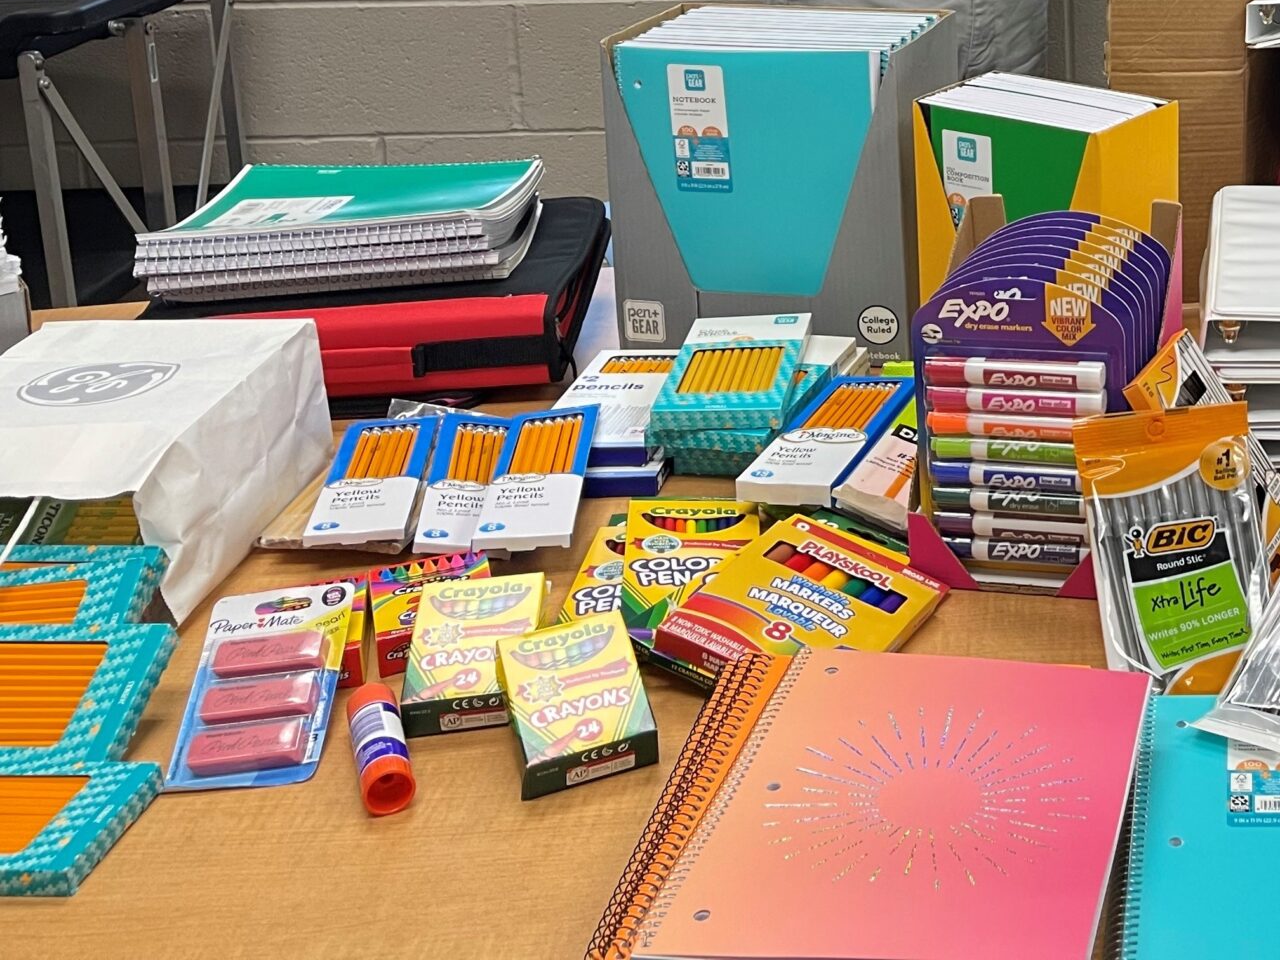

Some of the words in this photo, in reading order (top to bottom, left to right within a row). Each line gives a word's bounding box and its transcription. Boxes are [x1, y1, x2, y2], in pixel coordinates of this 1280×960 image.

[672, 95, 717, 104] NOTEBOOK
[946, 169, 990, 183] COMPOSITION
[946, 175, 964, 184] BOOK
[938, 298, 1010, 328] EXPO
[1049, 297, 1088, 318] NEW
[631, 319, 660, 336] GEAR
[862, 316, 896, 327] College
[964, 322, 978, 332] dry
[1000, 322, 1033, 333] markers
[1051, 316, 1086, 326] VIBRANT
[866, 326, 892, 335] Ruled
[1055, 324, 1082, 334] COLOR
[1061, 332, 1077, 341] MIX
[868, 351, 901, 361] tebook
[571, 383, 645, 392] pencils
[988, 373, 1038, 387] EXPO
[987, 396, 1036, 412] EXPO
[771, 451, 814, 459] Pencils
[1216, 448, 1231, 468] #1
[988, 473, 1037, 489] EXPO
[1214, 473, 1226, 482] Ball
[335, 488, 381, 498] Yellow
[440, 493, 485, 502] Yellow
[497, 492, 544, 502] Pencils
[500, 486, 544, 495] Yellow
[332, 494, 380, 504] Pencils
[437, 500, 484, 509] Pencils
[650, 506, 738, 517] Crayola
[31, 503, 61, 545] TICON
[321, 521, 331, 530] 8
[487, 522, 497, 531] 8
[431, 528, 441, 538] 8
[992, 541, 1041, 562] EXPO
[798, 540, 892, 590] PLAYSKOOL
[1156, 558, 1185, 571] Round
[901, 567, 926, 582] BROAD
[925, 577, 941, 589] LINE
[438, 581, 525, 600] Crayola
[791, 575, 852, 608] Washable
[1180, 577, 1222, 611] Life
[771, 576, 856, 621] MARKERS
[748, 586, 849, 638] MARQUEUR
[210, 619, 258, 635] Paper
[263, 615, 304, 629] Mate
[764, 621, 792, 641] 8
[1148, 626, 1179, 642] Writes
[1180, 619, 1200, 633] 90%
[1201, 607, 1240, 626] LONGER
[518, 621, 606, 654] Crayola
[670, 624, 707, 644] MARQUEUR
[706, 639, 733, 657] LAVABLE
[677, 617, 711, 636] NON-TOXIC
[710, 633, 744, 652] WASHABLE
[420, 646, 497, 671] CRAYO
[455, 671, 478, 686] 24
[678, 666, 704, 682] CRAYOLA
[529, 686, 632, 729] CRAYONS
[576, 719, 601, 739] 24
